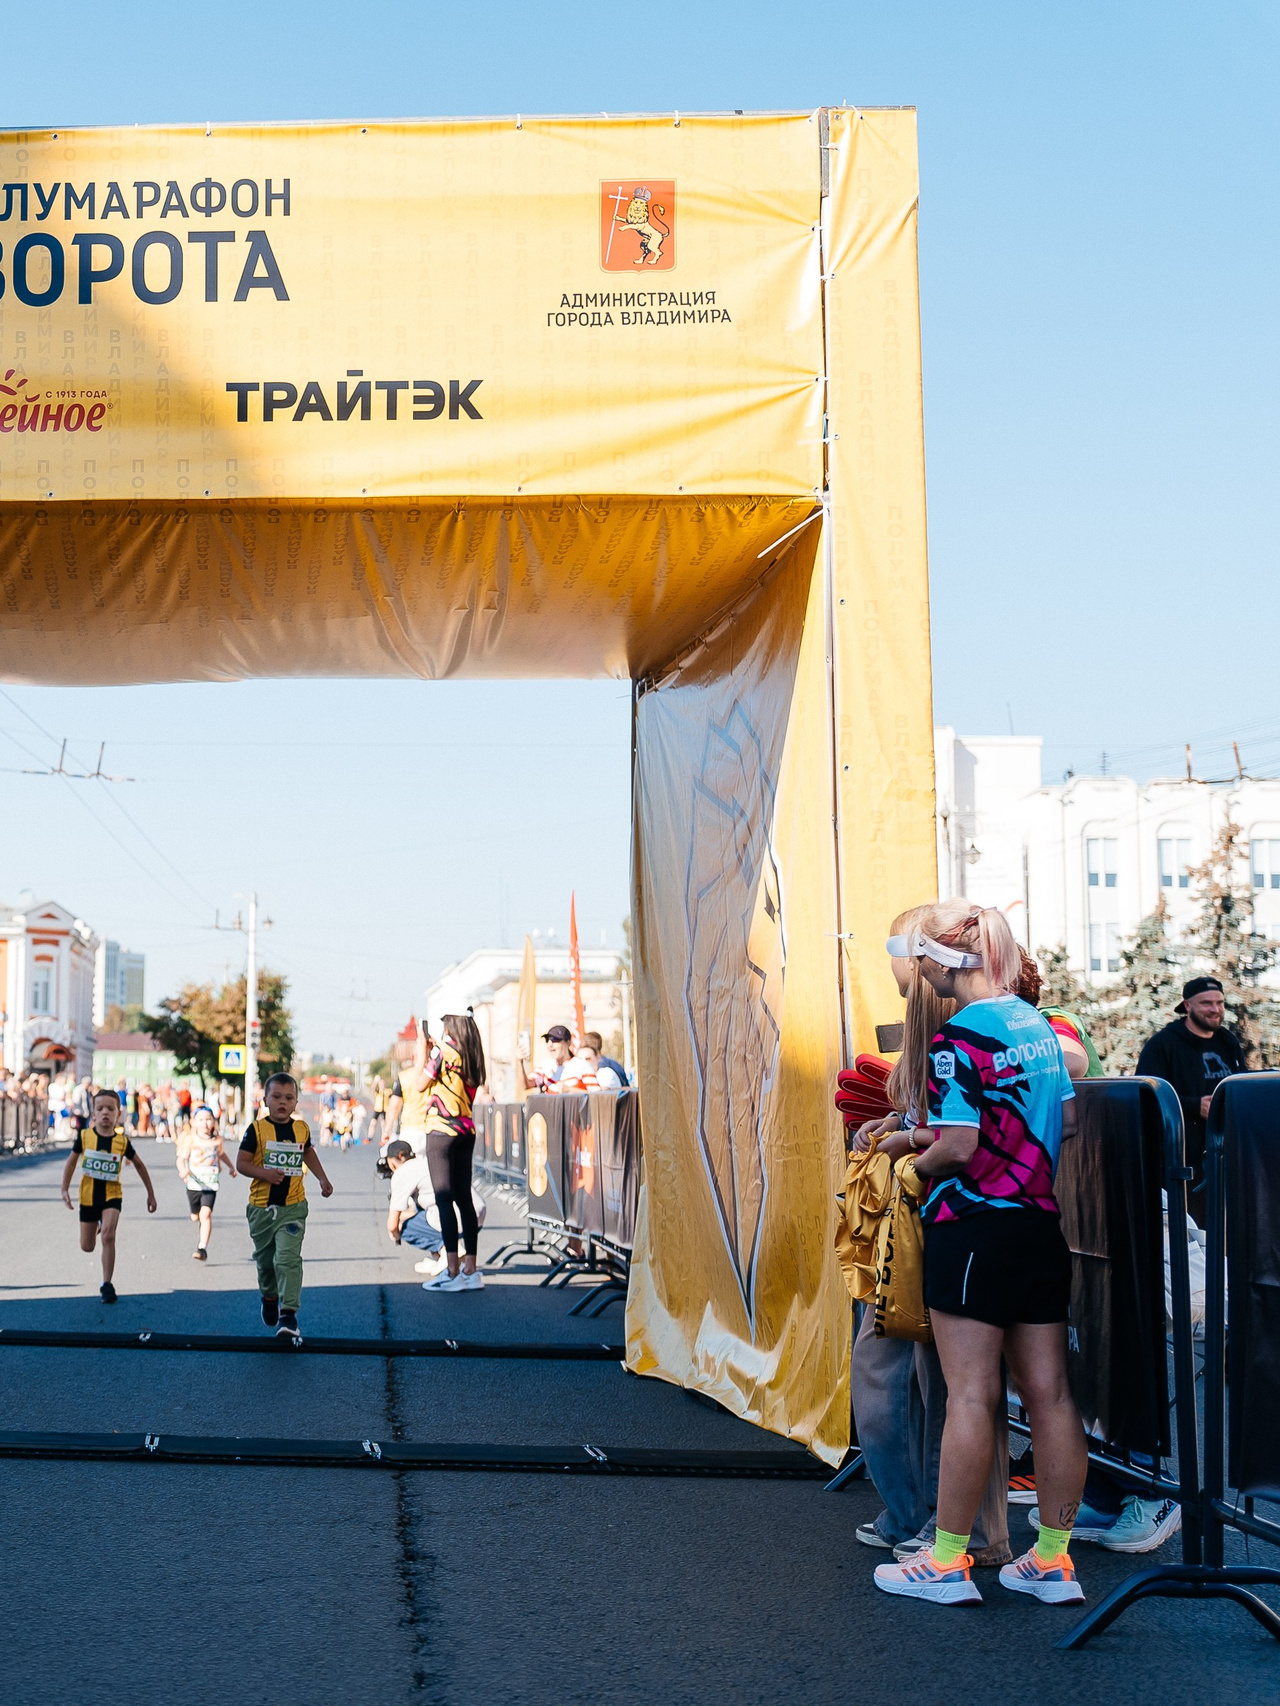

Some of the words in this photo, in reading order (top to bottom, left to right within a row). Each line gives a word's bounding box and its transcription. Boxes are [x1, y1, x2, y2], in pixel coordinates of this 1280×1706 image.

[559, 291, 716, 308] АДМИНИСТРАЦИЯ
[547, 311, 614, 328] ГОРОДА
[620, 308, 732, 327] ВЛАДИМИРА
[80, 390, 108, 399] ГОДА
[225, 370, 484, 423] ТРАЙТЭК
[86, 1158, 116, 1172] 5069
[269, 1152, 302, 1166] 5047
[1152, 1500, 1175, 1528] HOKA
